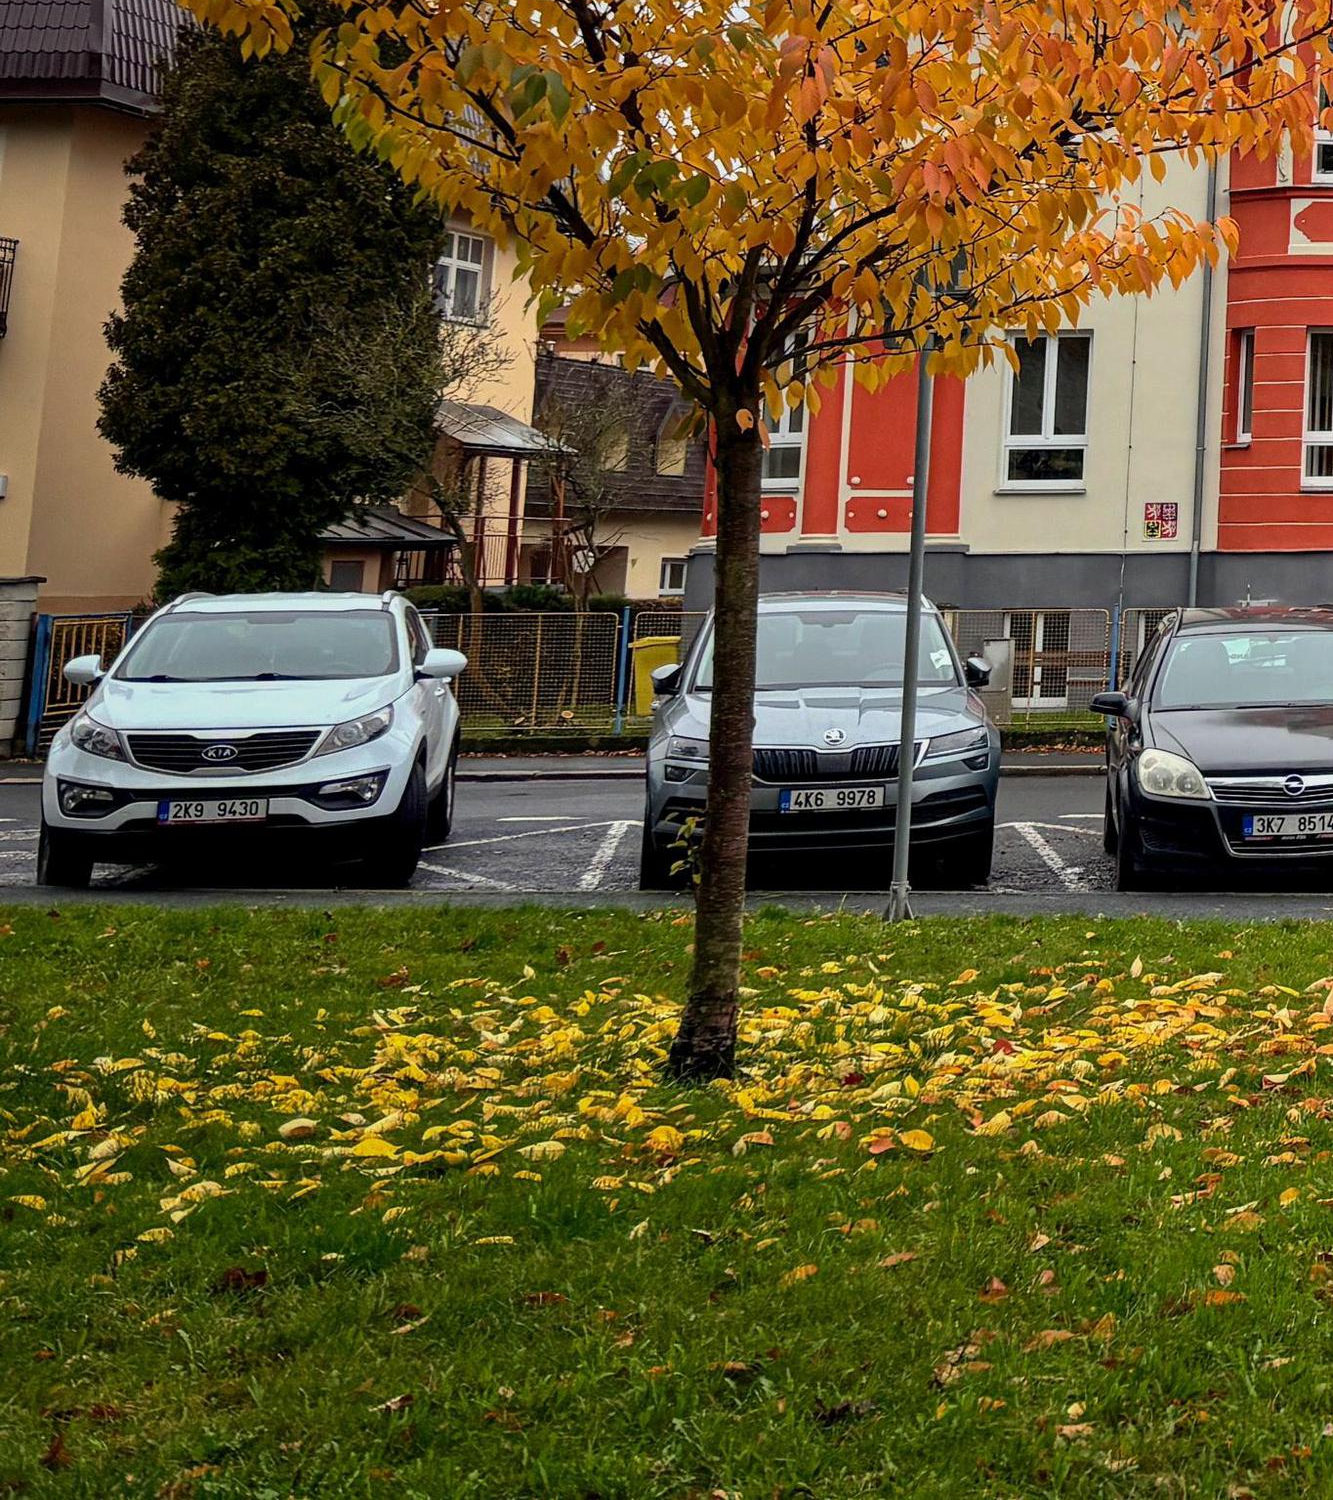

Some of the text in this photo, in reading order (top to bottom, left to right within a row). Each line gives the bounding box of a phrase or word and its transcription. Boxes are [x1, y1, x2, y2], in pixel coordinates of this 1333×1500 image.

[208, 749, 231, 758] KIA
[794, 791, 824, 808] 4K6
[836, 790, 876, 806] 9978
[172, 803, 204, 819] 2K9
[217, 801, 259, 817] 9430
[1256, 817, 1286, 833] 3K7
